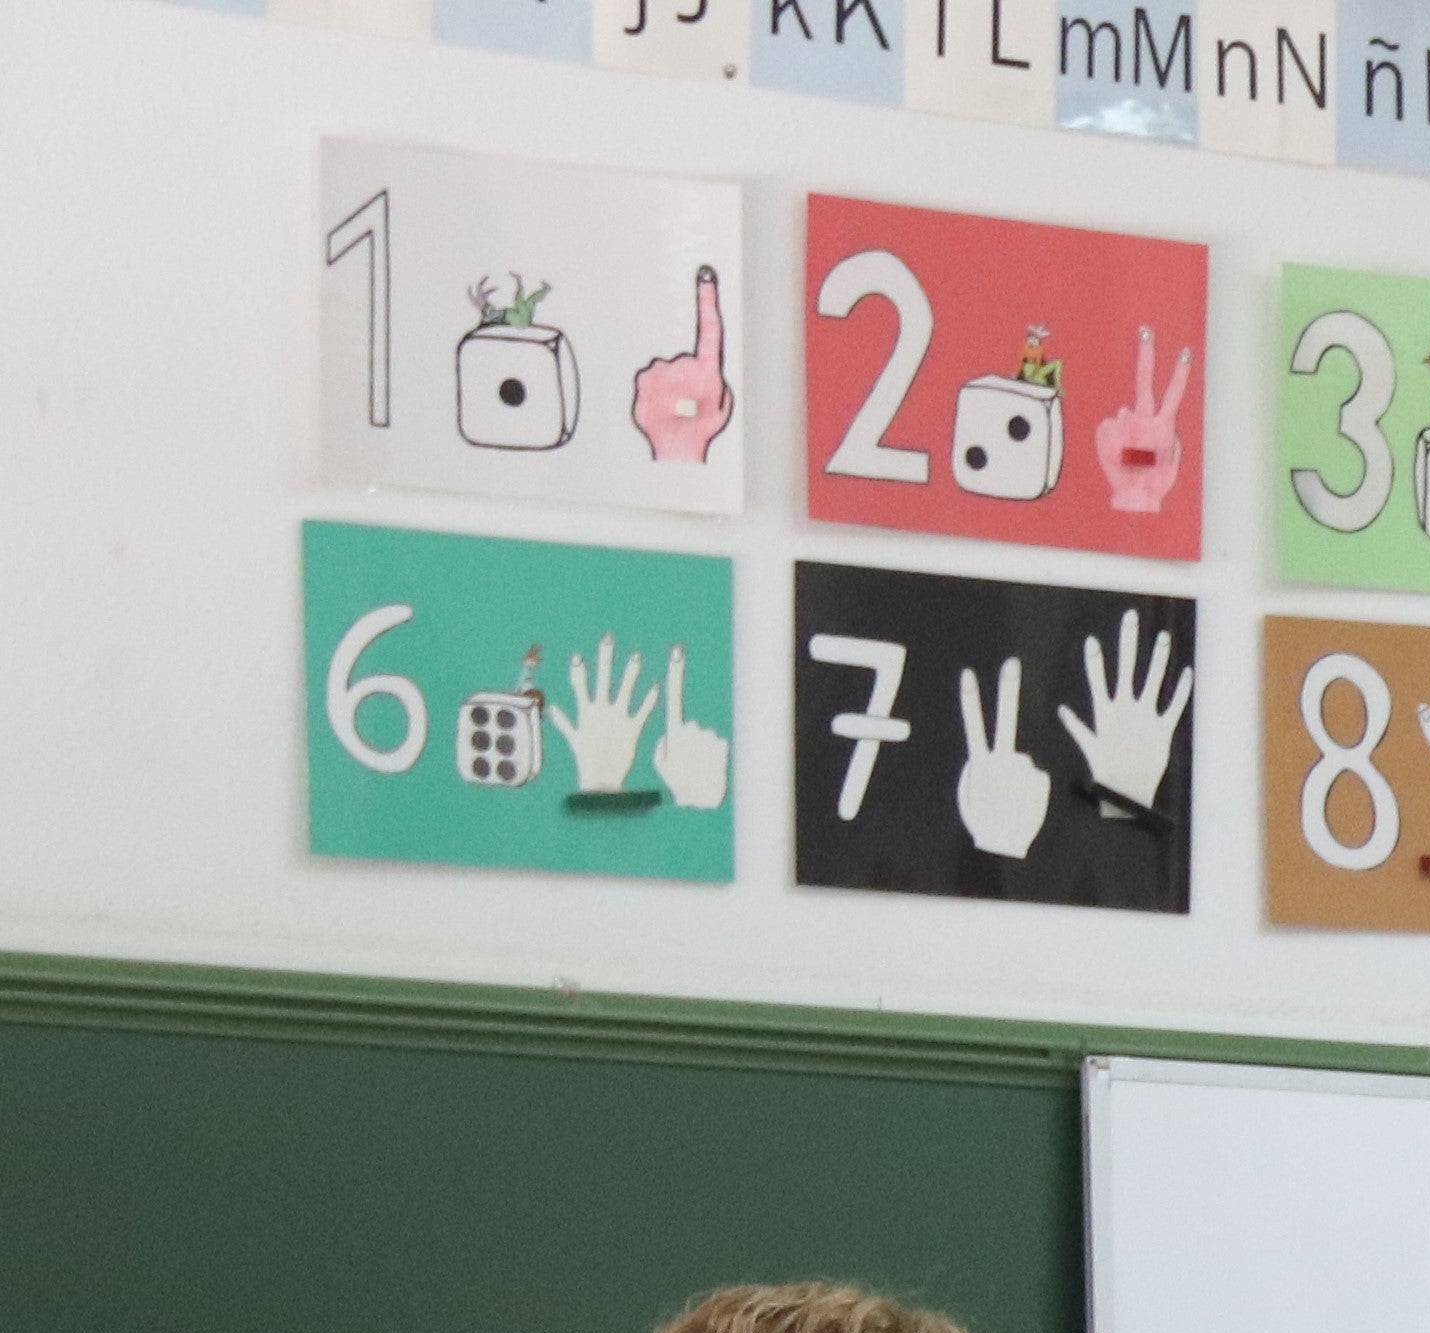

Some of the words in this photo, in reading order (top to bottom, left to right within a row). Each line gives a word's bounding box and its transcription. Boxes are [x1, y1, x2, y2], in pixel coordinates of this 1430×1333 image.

[1060, 8, 1191, 93] mM
[1217, 28, 1326, 109] nN
[326, 188, 390, 428] 1
[816, 249, 935, 484] 2
[1289, 308, 1397, 533] 3
[325, 603, 428, 774] 6
[808, 633, 911, 821] 7
[1299, 652, 1400, 870] 8
